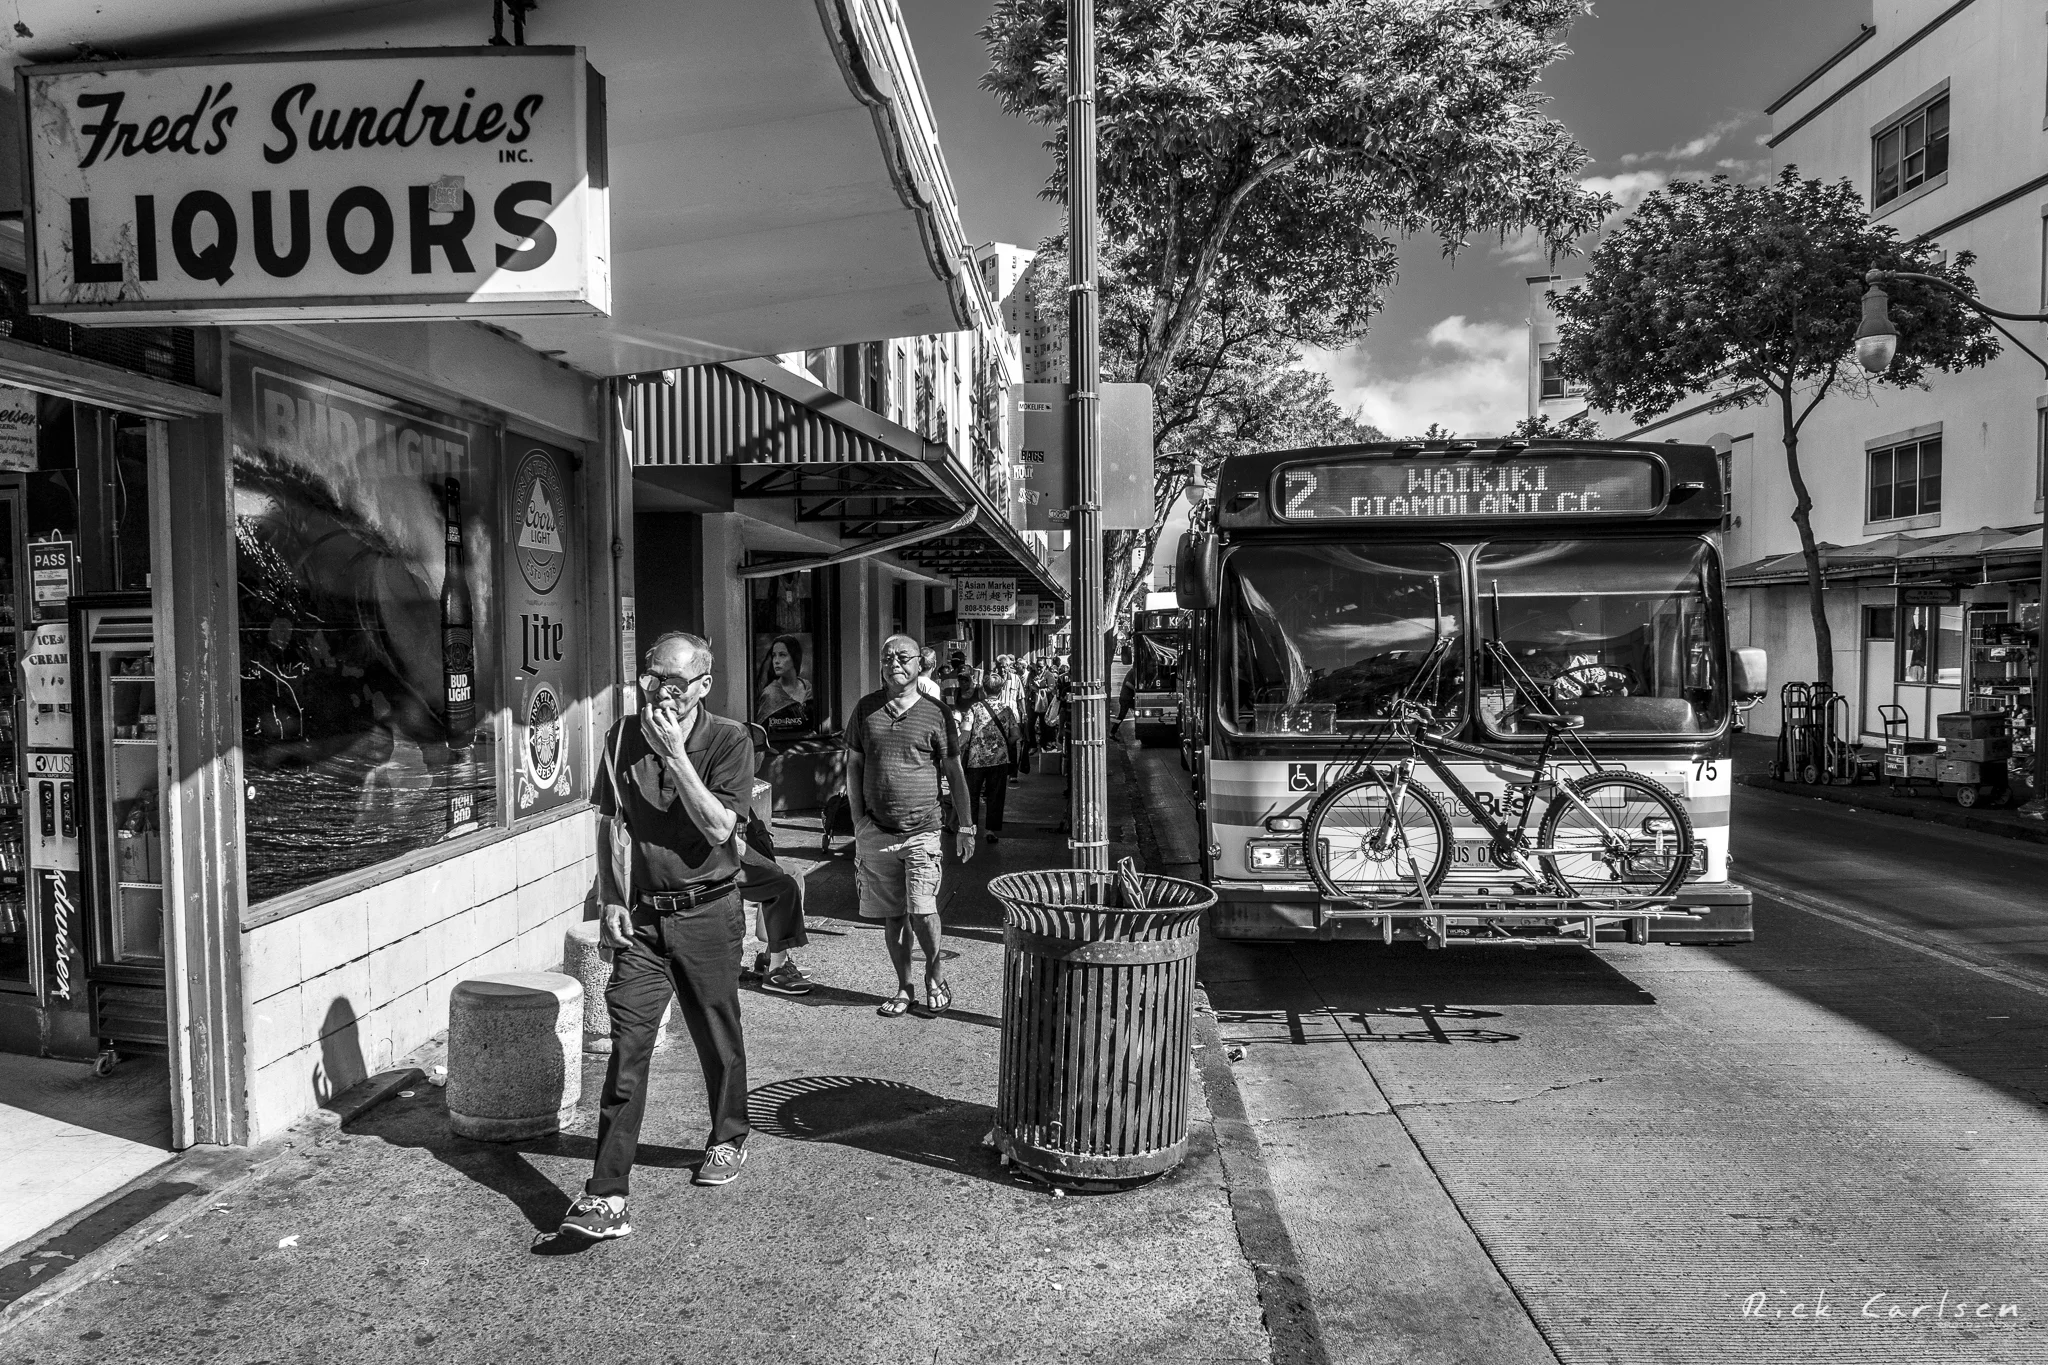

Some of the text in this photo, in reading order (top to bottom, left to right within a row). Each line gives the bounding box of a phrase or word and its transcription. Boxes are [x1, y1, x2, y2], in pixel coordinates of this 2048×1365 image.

[77, 79, 544, 168] Fred's Sundries
[499, 149, 533, 163] INC.
[69, 180, 558, 286] LIQUORS
[264, 388, 464, 479] BUD LIGHT
[1285, 465, 1548, 518] 2 WAIKIKI
[526, 500, 555, 531] Coors
[531, 530, 550, 545] LIGHT
[34, 553, 66, 567] PASS
[964, 580, 986, 590] Asian
[987, 580, 1015, 590] Market
[964, 590, 1015, 601] 亞洲超市
[964, 604, 1009, 612] 808-536-5985
[37, 635, 56, 645] ICE
[519, 613, 564, 676] Lite
[29, 654, 68, 665] CREAM
[450, 674, 467, 688] BUD
[448, 687, 471, 701] LIGHT
[537, 760, 556, 779] BEER
[1692, 760, 1717, 781] 75
